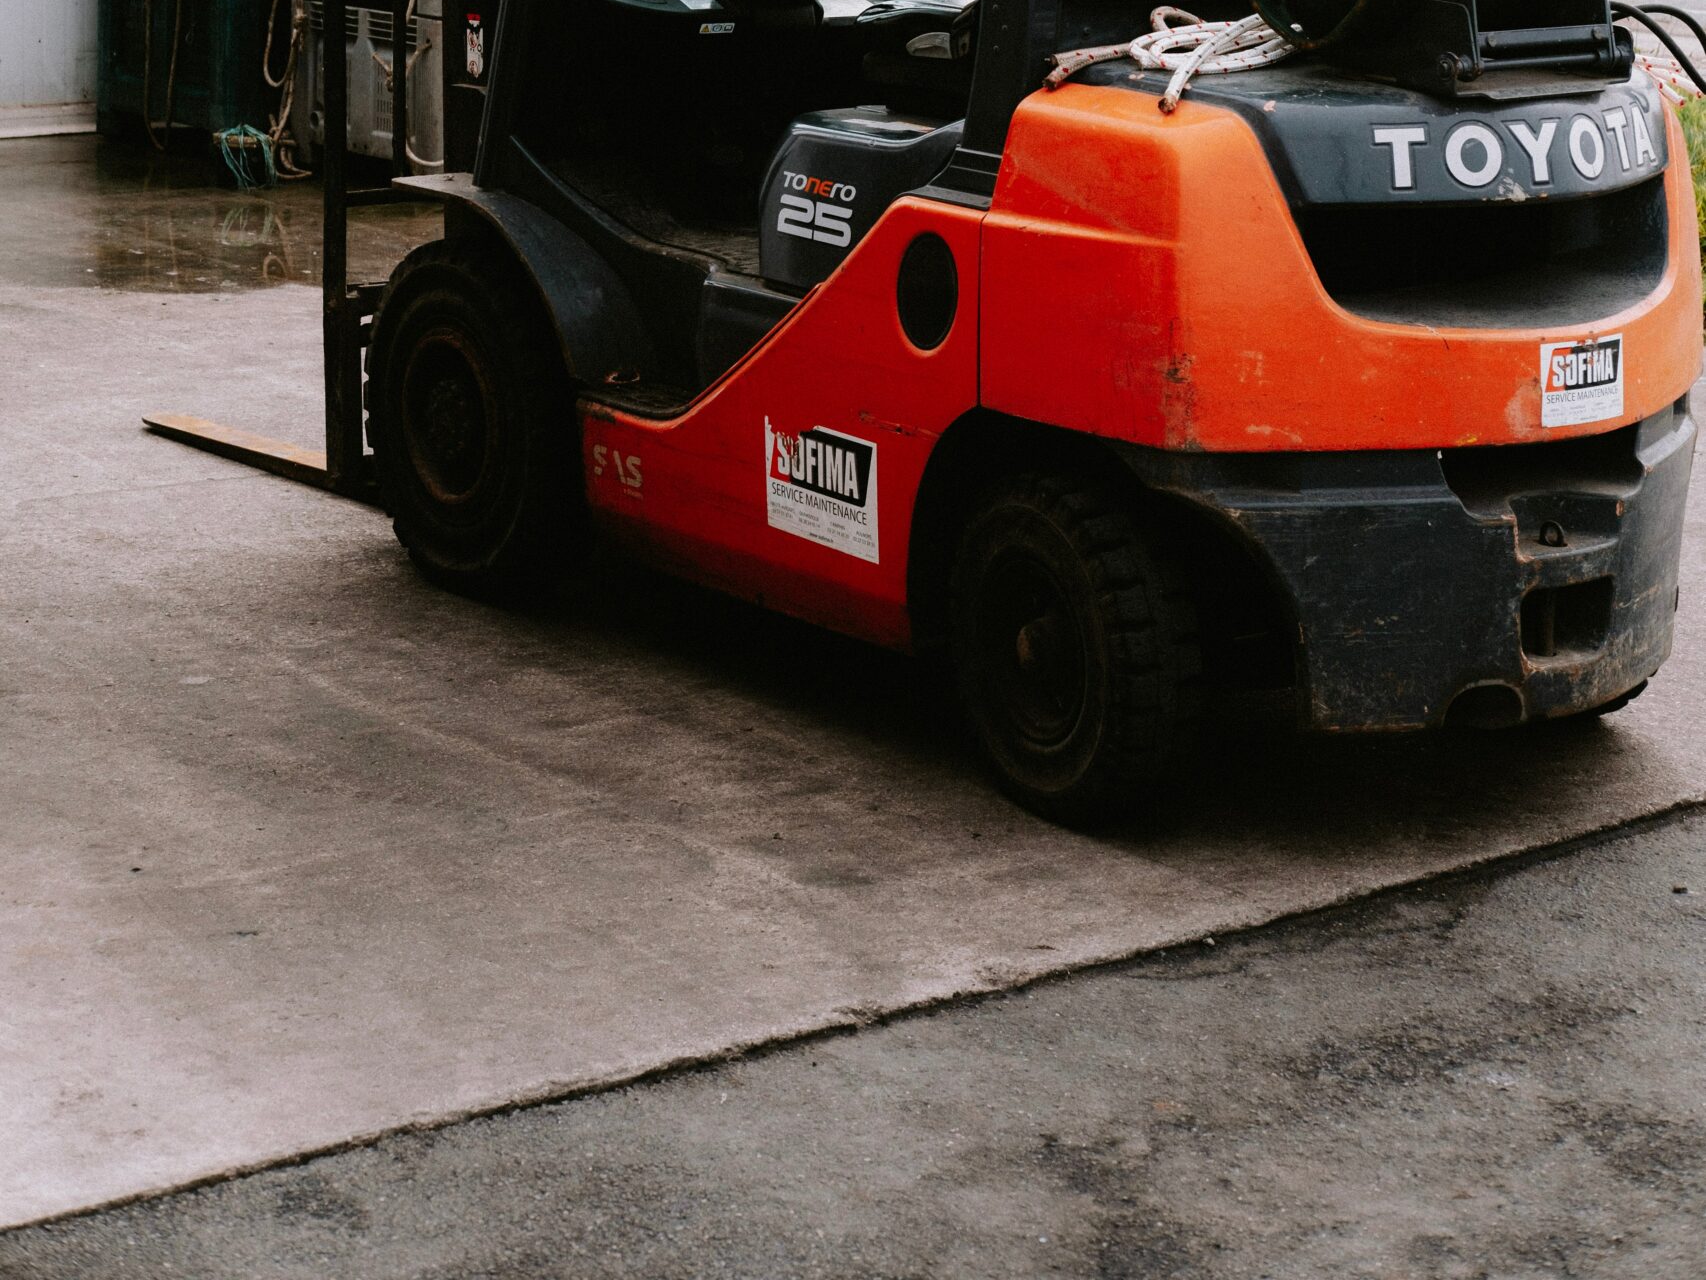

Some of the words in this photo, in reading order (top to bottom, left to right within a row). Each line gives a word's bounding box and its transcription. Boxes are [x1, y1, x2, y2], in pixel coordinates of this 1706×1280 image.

[1373, 105, 1656, 188] TOYOTA
[777, 193, 853, 247] 25
[1552, 348, 1614, 387] SOFIMA
[1546, 392, 1576, 404] SERVICE
[1577, 386, 1618, 400] MAINTENANCE
[776, 431, 859, 499] SOFIMA
[771, 481, 803, 505] SERVICE
[805, 493, 867, 525] MAINTENANCE
